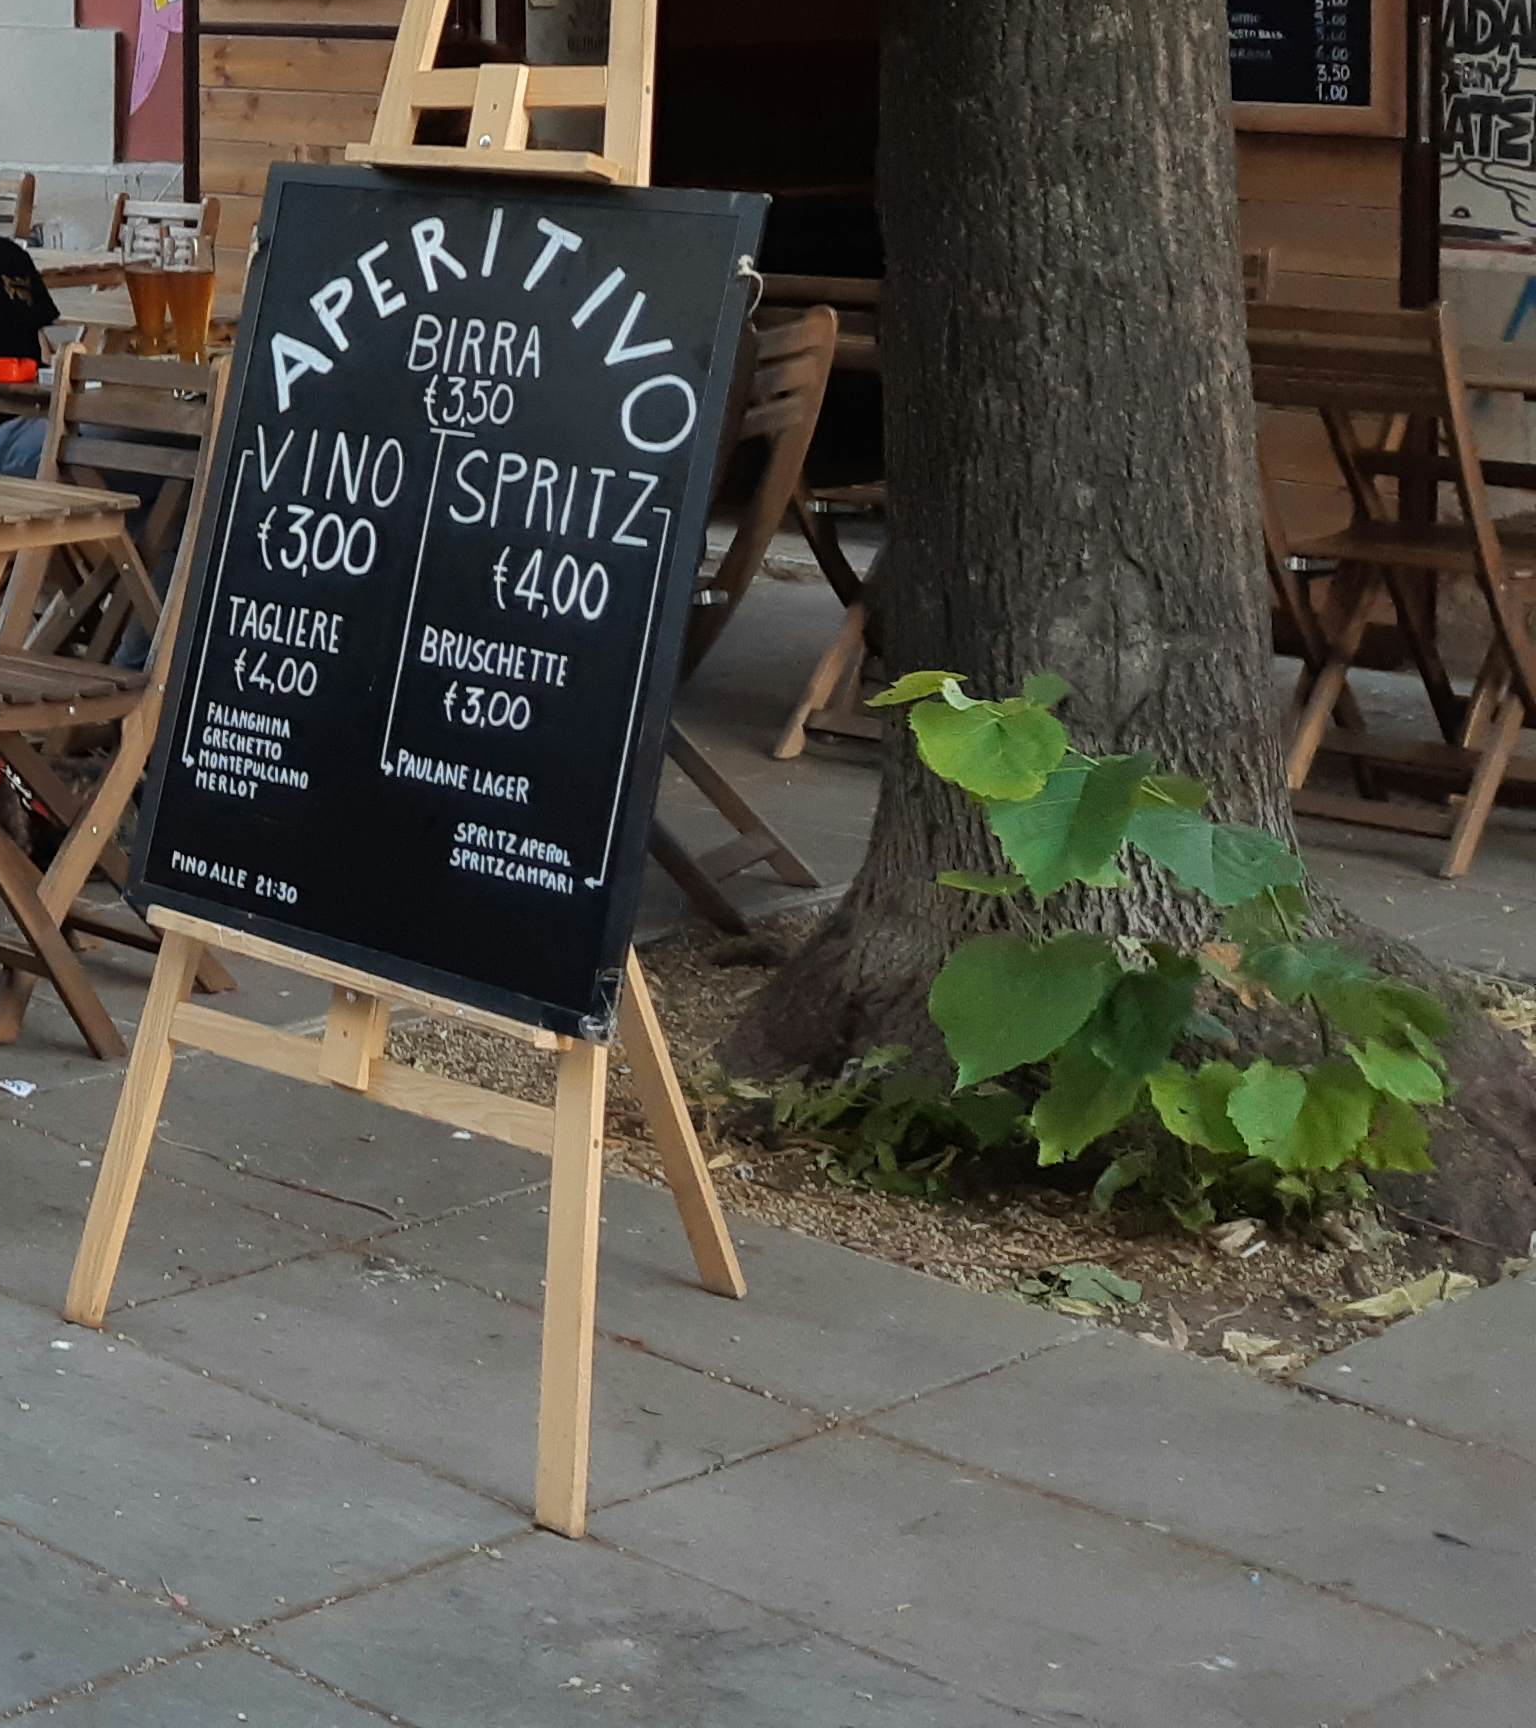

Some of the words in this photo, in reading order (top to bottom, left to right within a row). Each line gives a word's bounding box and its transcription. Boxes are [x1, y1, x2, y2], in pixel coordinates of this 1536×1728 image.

[1316, 64, 1351, 82] 3.50
[1317, 83, 1349, 102] 1.00
[269, 206, 697, 454] APERITIVO
[407, 312, 542, 379] BIRRA
[256, 424, 405, 509] VINO
[447, 448, 660, 548] SPRITZ
[227, 594, 345, 655] TAGLIERE
[419, 624, 570, 689] BRUSCHETTE
[202, 725, 283, 761] GRECHETTO
[206, 701, 292, 740] FALANGHINA
[194, 770, 260, 800] MERLOT
[197, 747, 310, 791] MONTEPULCIANO
[396, 747, 470, 791] PAULANE
[472, 768, 530, 804] LAGER
[453, 822, 518, 855] SPRITZ
[519, 837, 572, 868] APEROL
[208, 861, 249, 890] ALLE
[254, 874, 299, 905] 21:30
